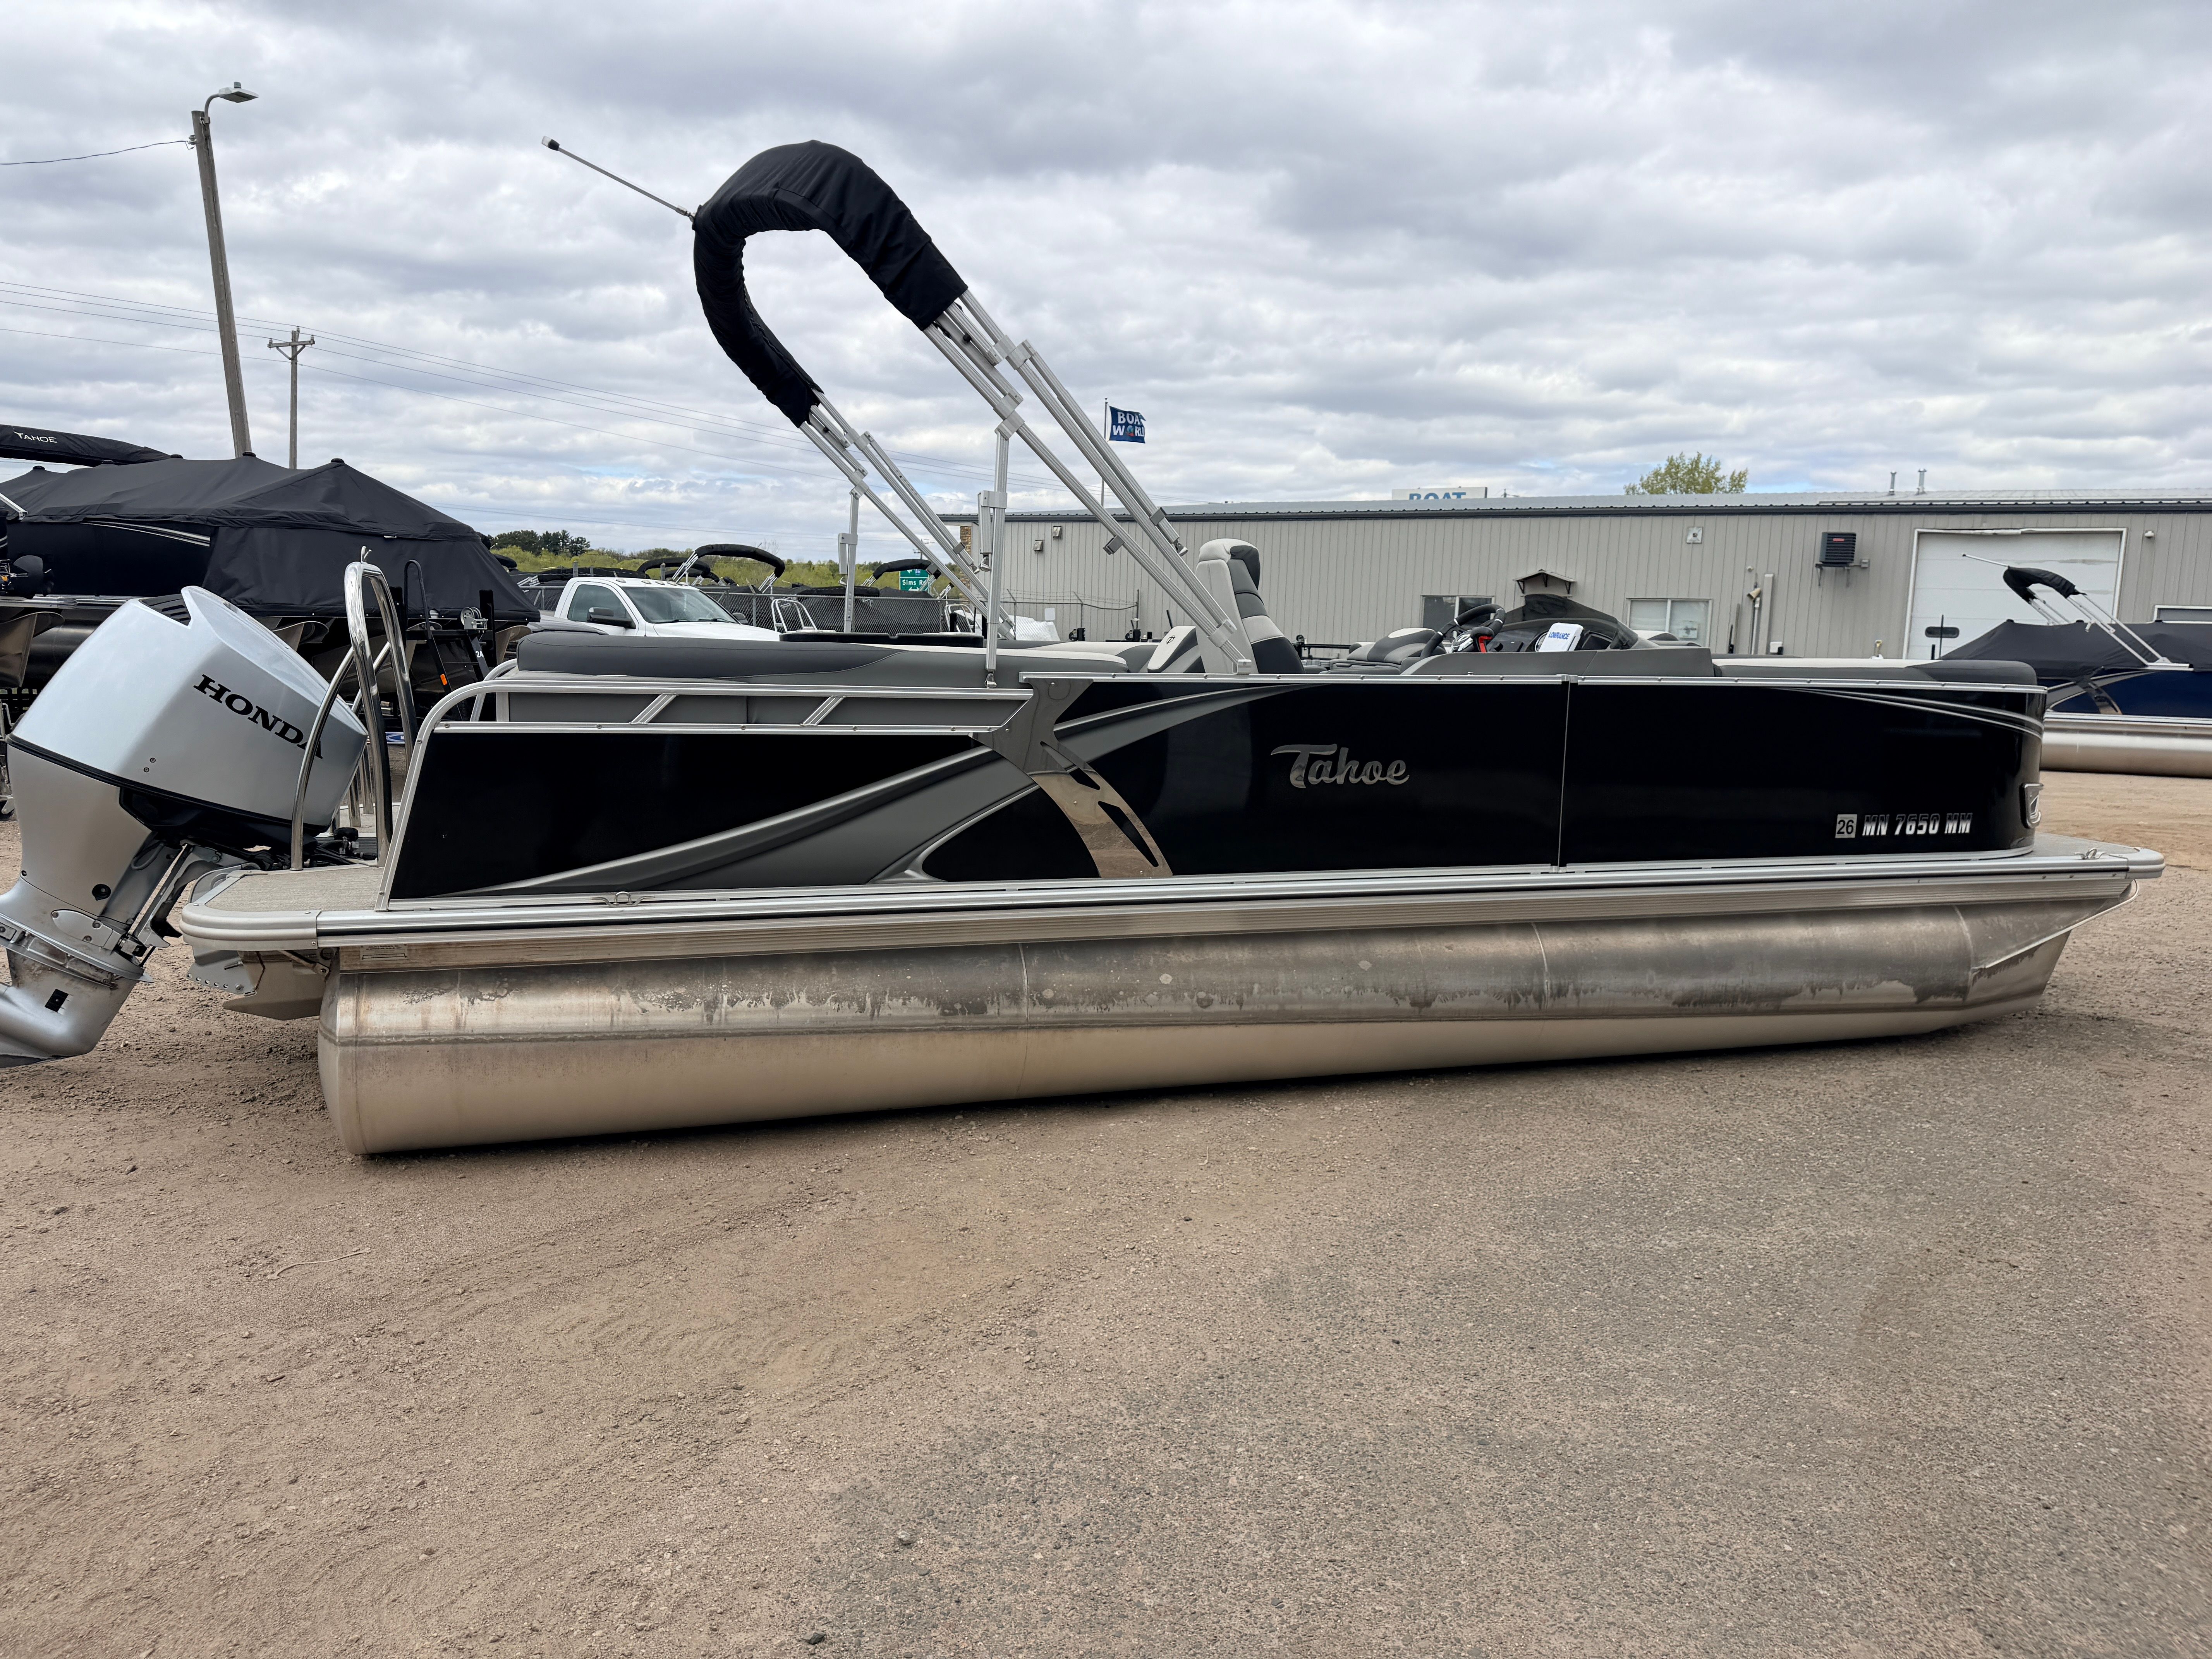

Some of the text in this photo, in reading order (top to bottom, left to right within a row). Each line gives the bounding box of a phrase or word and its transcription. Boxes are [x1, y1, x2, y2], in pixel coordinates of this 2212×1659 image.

[1117, 411, 1142, 425] BOA
[13, 431, 58, 443] TAHOE
[1271, 744, 1410, 788] Tahoe
[1837, 819, 1855, 835] 26
[1862, 813, 1973, 836] MN 7650 MM
